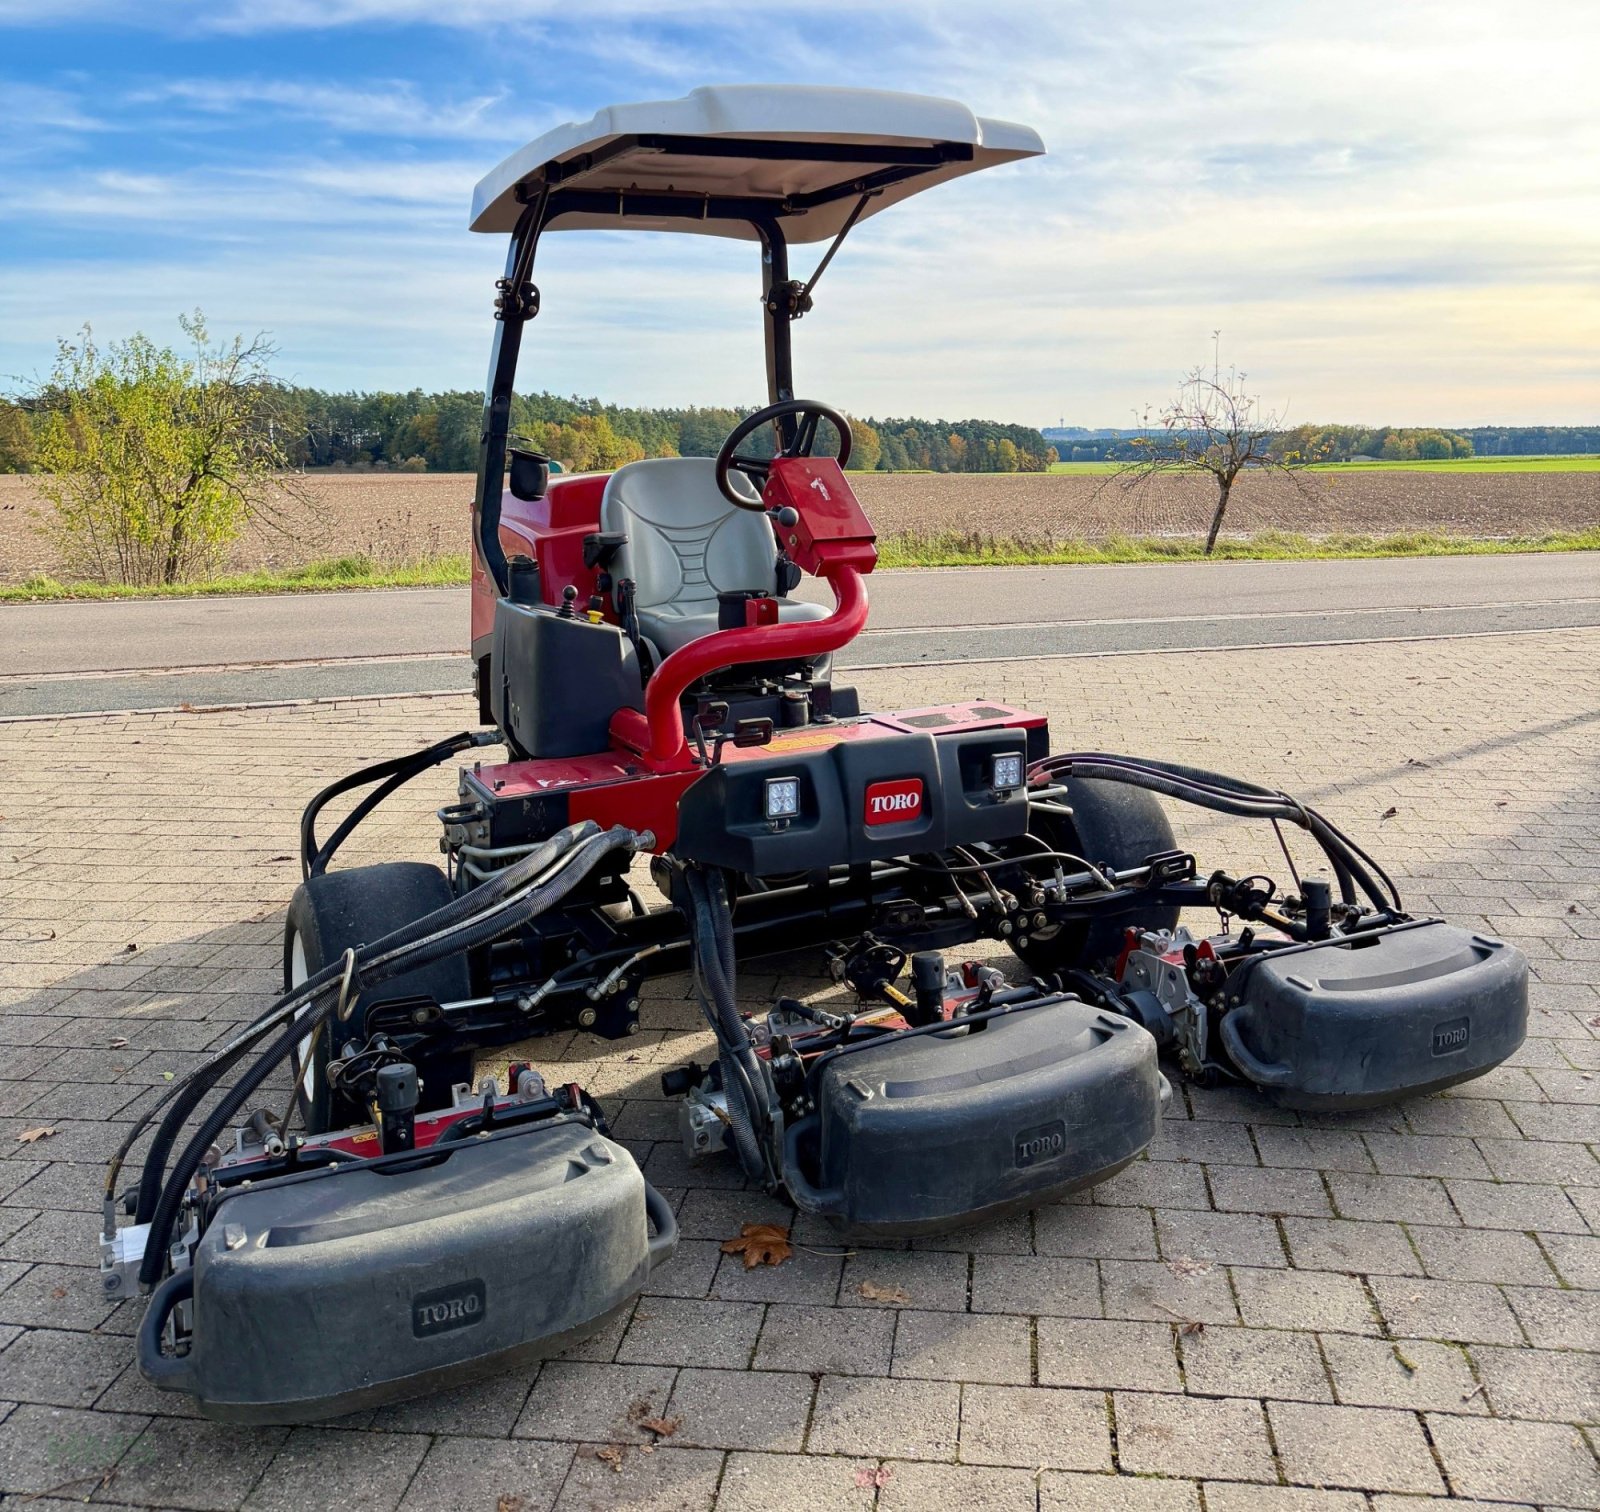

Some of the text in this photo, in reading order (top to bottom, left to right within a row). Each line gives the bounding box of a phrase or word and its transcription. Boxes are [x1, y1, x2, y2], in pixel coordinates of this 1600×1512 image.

[870, 791, 920, 813] TORO
[1436, 1027, 1467, 1047] TORO
[1019, 1133, 1062, 1158] TORO
[419, 1294, 479, 1326] TORO
